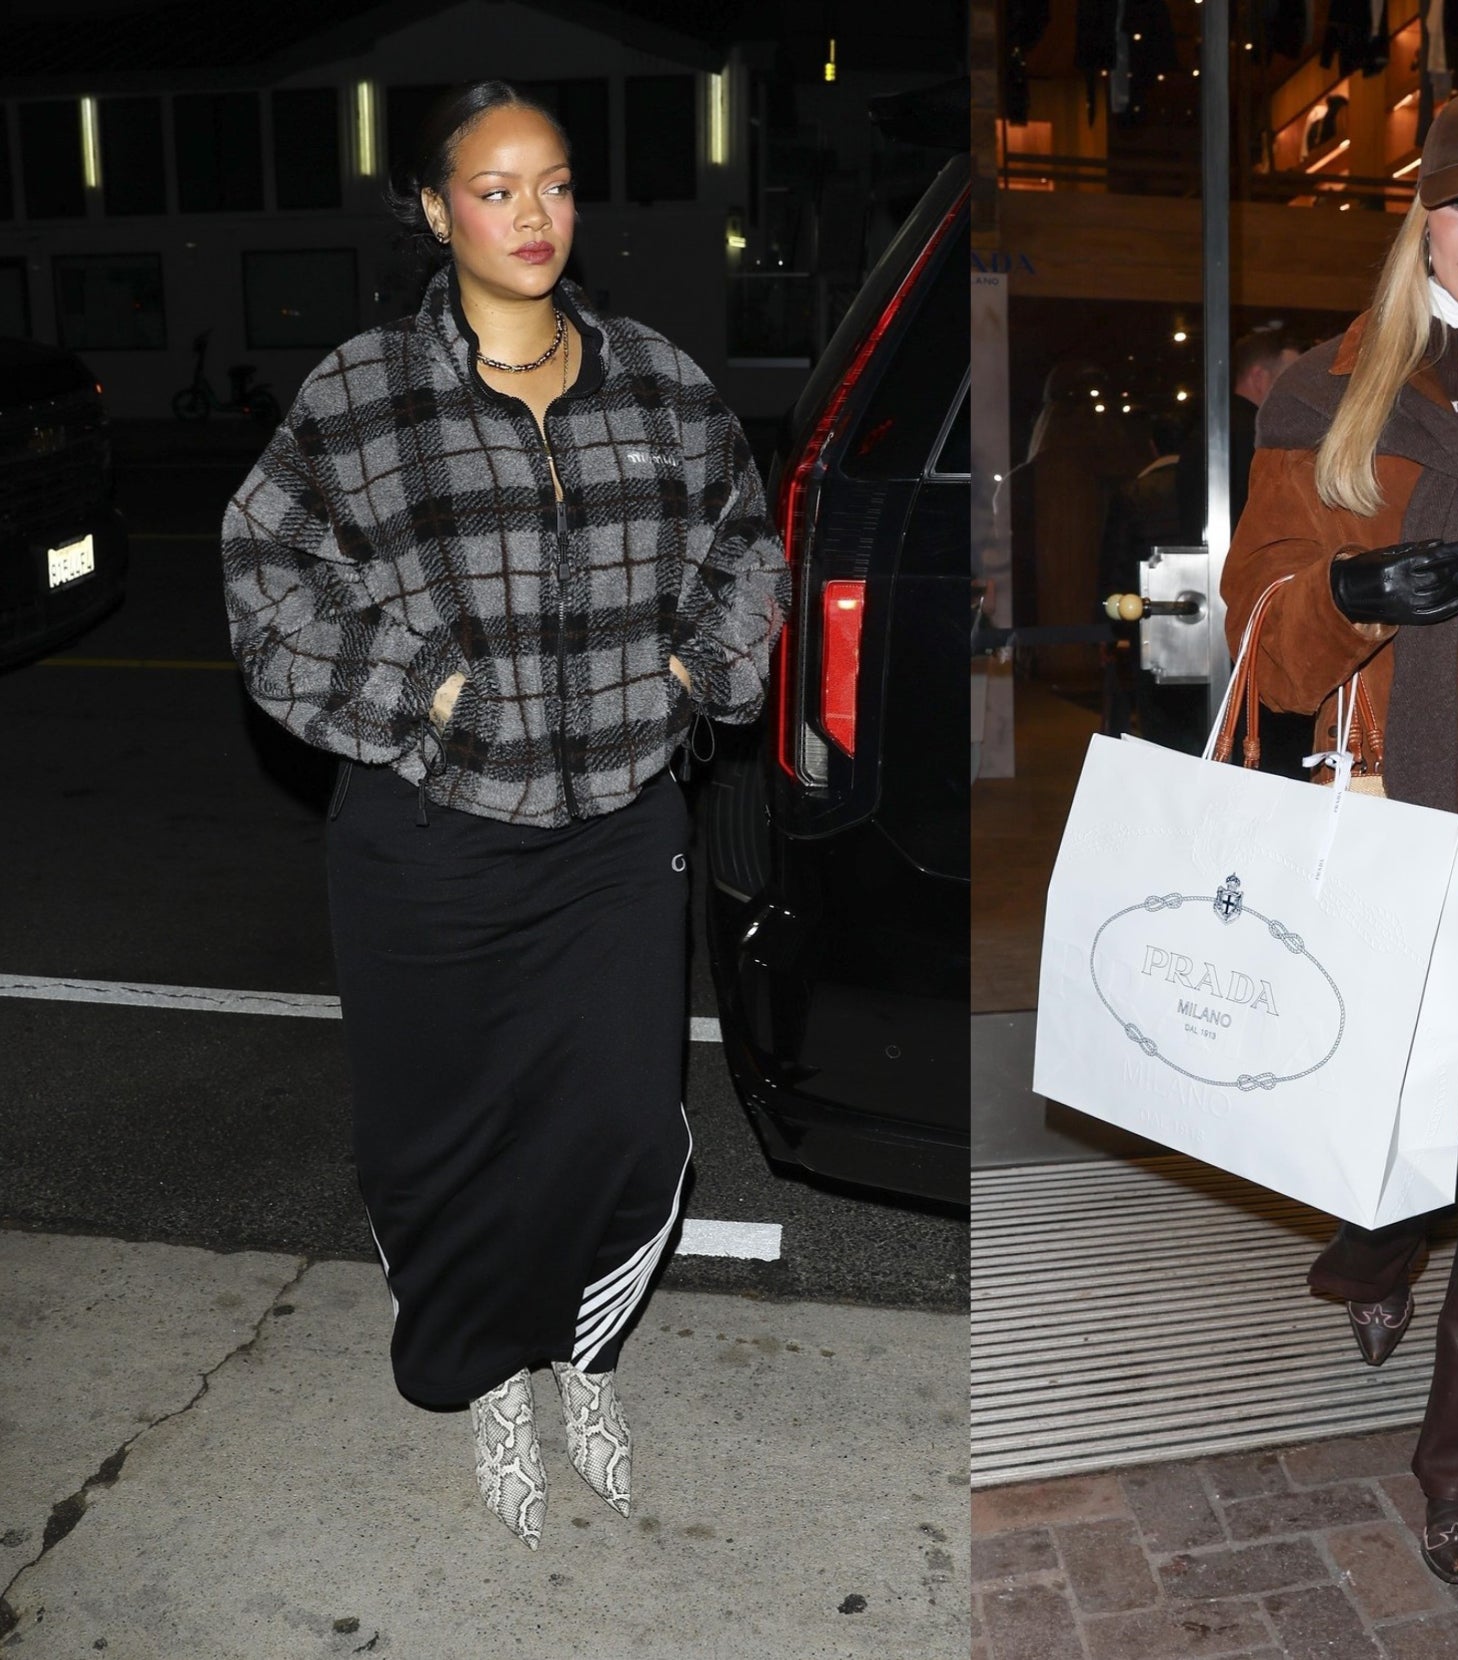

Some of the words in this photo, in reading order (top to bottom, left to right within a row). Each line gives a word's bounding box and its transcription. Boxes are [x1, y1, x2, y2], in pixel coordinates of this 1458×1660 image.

[1140, 944, 1280, 1017] PRADA
[1176, 998, 1233, 1029] MILANO
[1184, 1023, 1198, 1035] DAL
[1200, 1027, 1217, 1041] 1913
